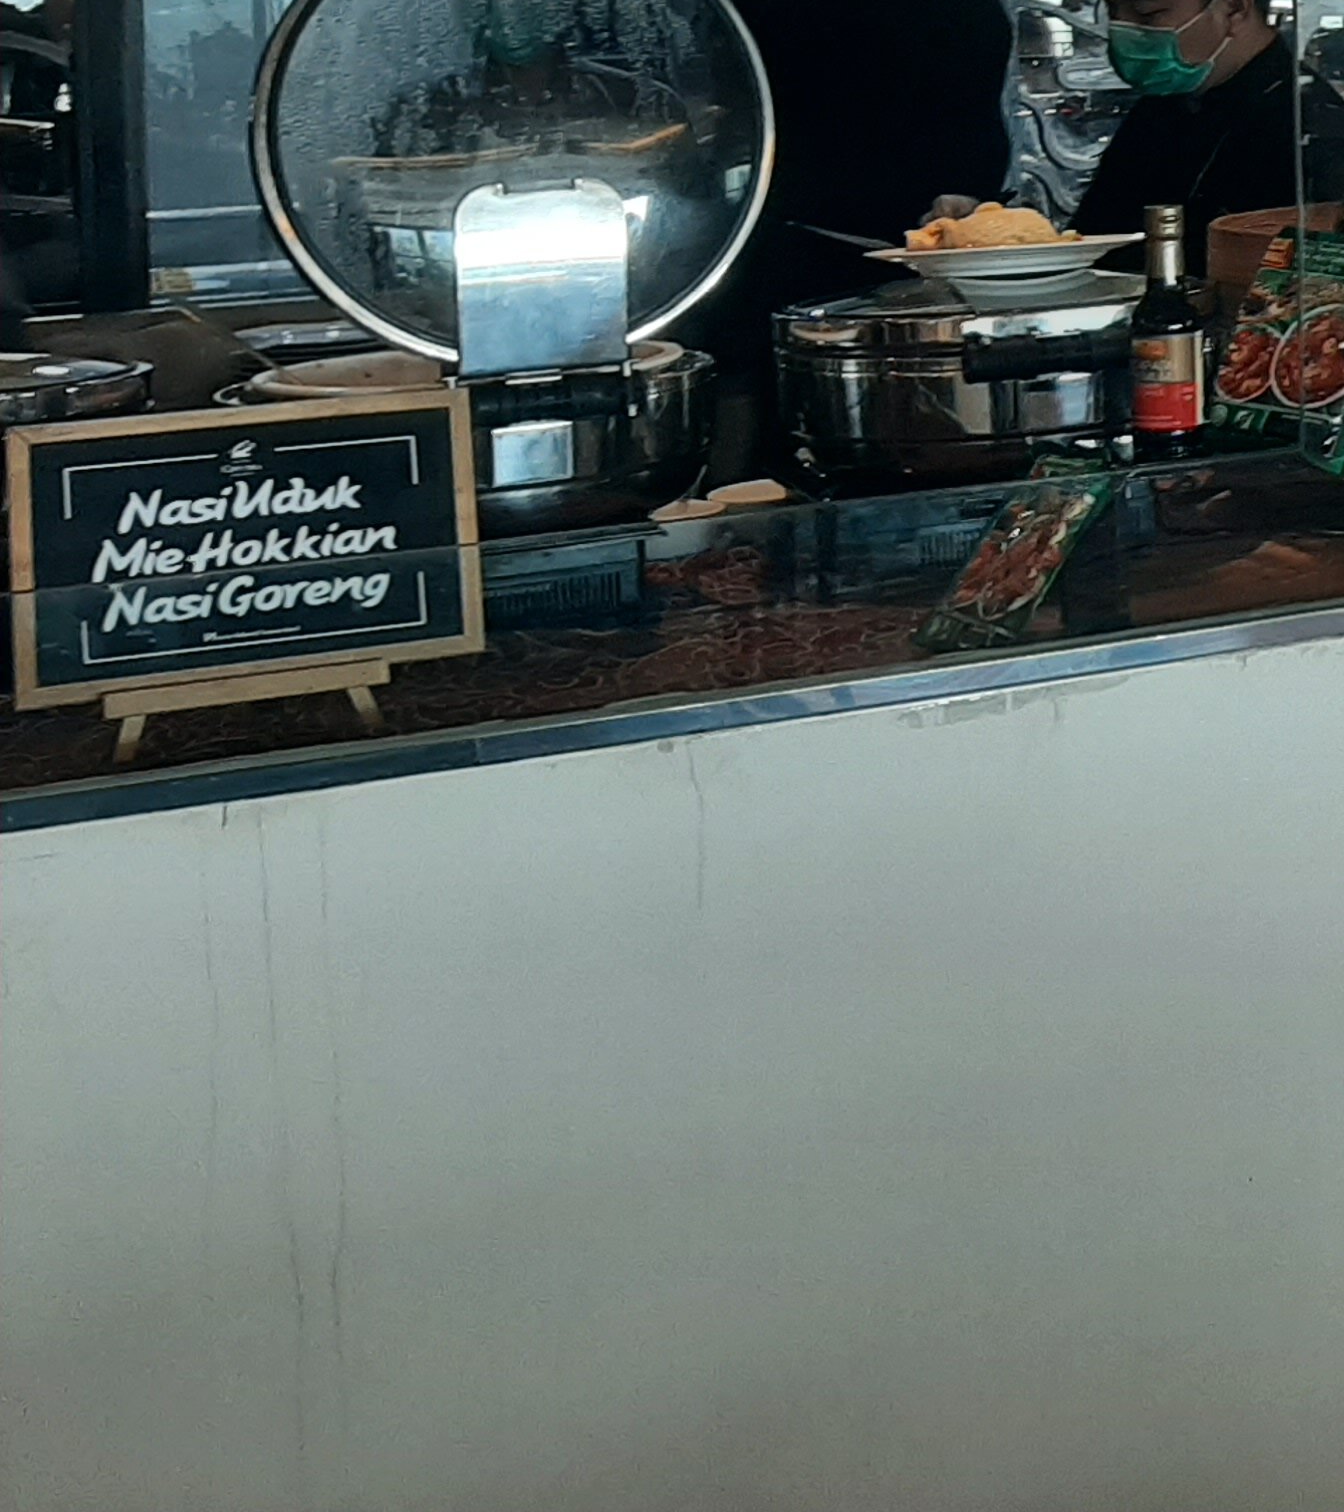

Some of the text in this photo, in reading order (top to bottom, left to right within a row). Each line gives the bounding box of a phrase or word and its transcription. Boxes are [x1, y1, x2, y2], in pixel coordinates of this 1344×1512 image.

[117, 475, 362, 534] Nasi Uduk
[92, 522, 397, 583] Mie Hokkian
[102, 571, 391, 633] Nasi Goreng
